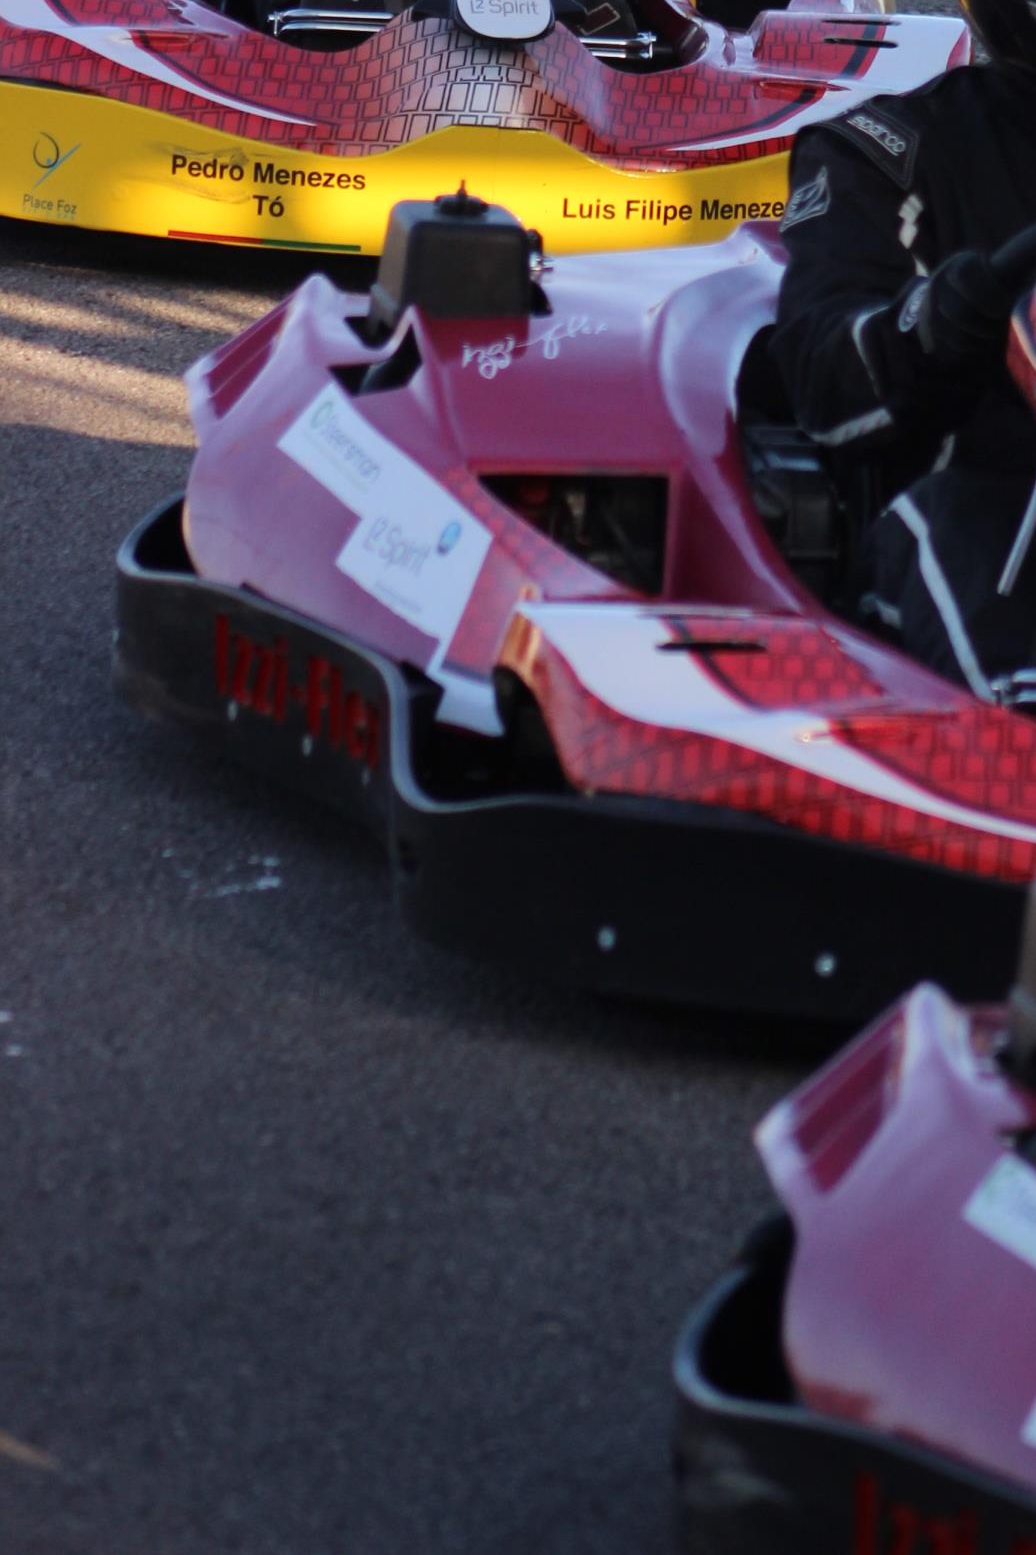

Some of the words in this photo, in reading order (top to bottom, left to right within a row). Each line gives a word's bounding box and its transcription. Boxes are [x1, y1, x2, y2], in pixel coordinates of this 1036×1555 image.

[171, 154, 244, 182] Pedro
[252, 162, 366, 190] Menezes
[22, 193, 54, 211] Place
[57, 199, 77, 215] Foz
[252, 195, 284, 218] Tó
[562, 198, 615, 219] Luis
[625, 199, 692, 225] Filipe
[700, 199, 785, 221] Meneze
